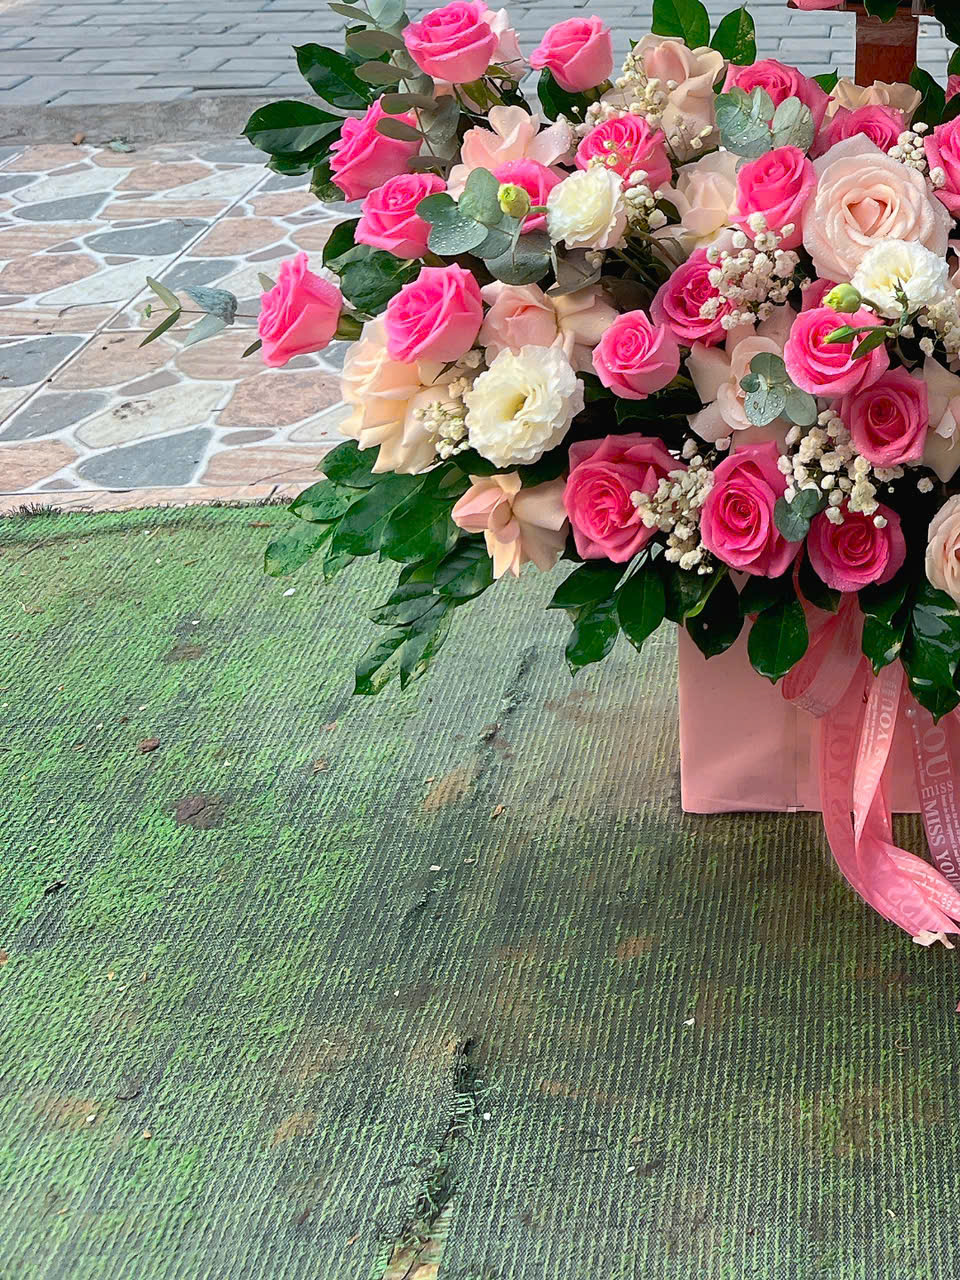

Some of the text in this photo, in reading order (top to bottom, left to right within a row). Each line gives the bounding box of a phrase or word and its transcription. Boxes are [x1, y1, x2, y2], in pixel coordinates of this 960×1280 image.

[923, 727, 951, 781] OU
[923, 799, 946, 847] MISS
[936, 849, 960, 885] YOU
